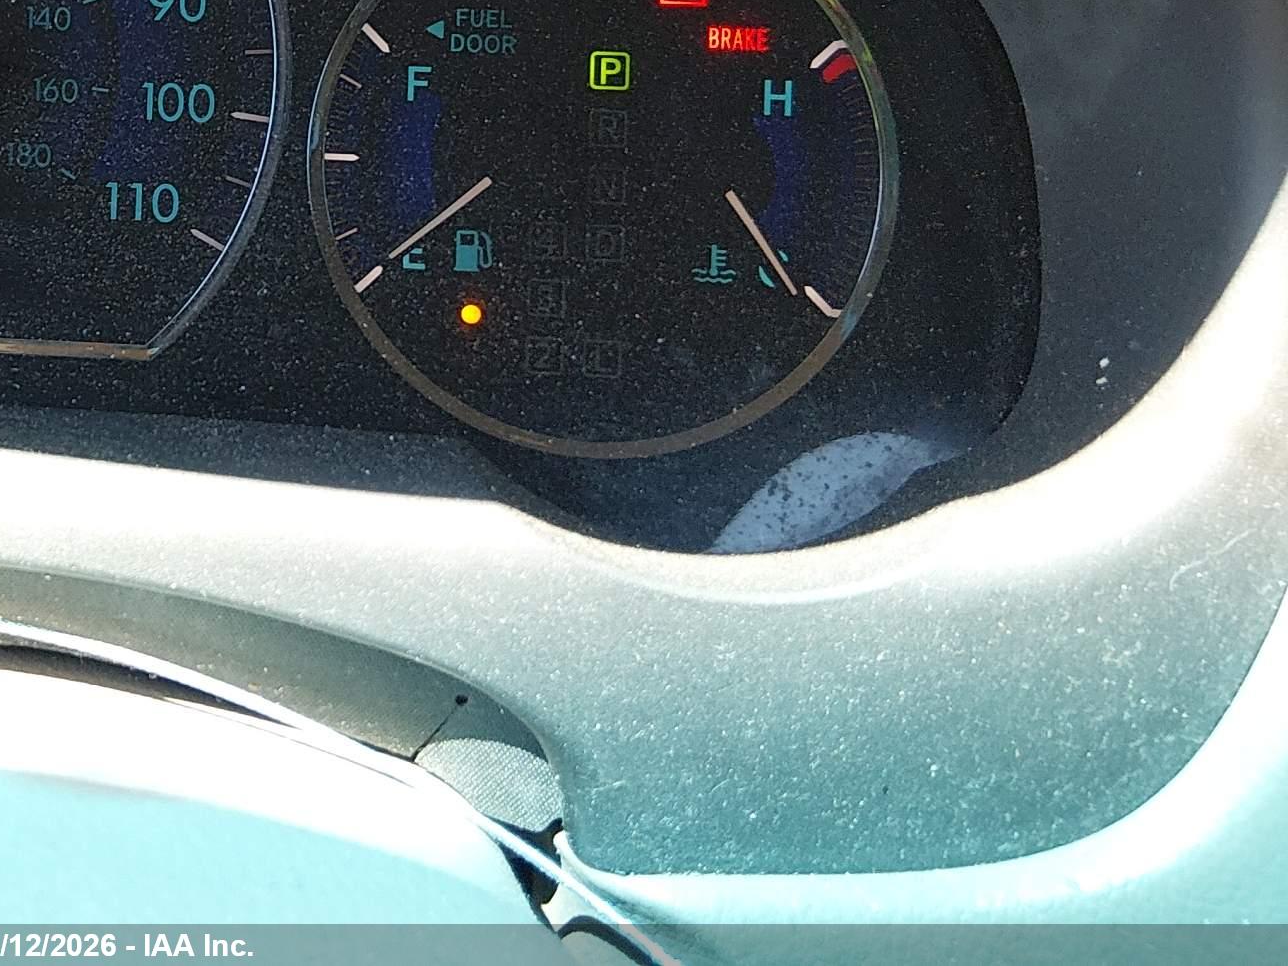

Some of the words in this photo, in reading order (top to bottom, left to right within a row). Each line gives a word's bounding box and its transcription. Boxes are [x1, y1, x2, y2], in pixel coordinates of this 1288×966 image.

[26, 6, 71, 31] 140
[456, 8, 511, 30] FUEL
[451, 33, 515, 54] DOOR
[708, 27, 768, 52] BRAKE
[407, 66, 432, 101] F
[601, 59, 620, 85] P
[34, 78, 79, 104] 160
[143, 82, 214, 123] 100
[764, 80, 792, 116] H
[108, 183, 179, 224] 110
